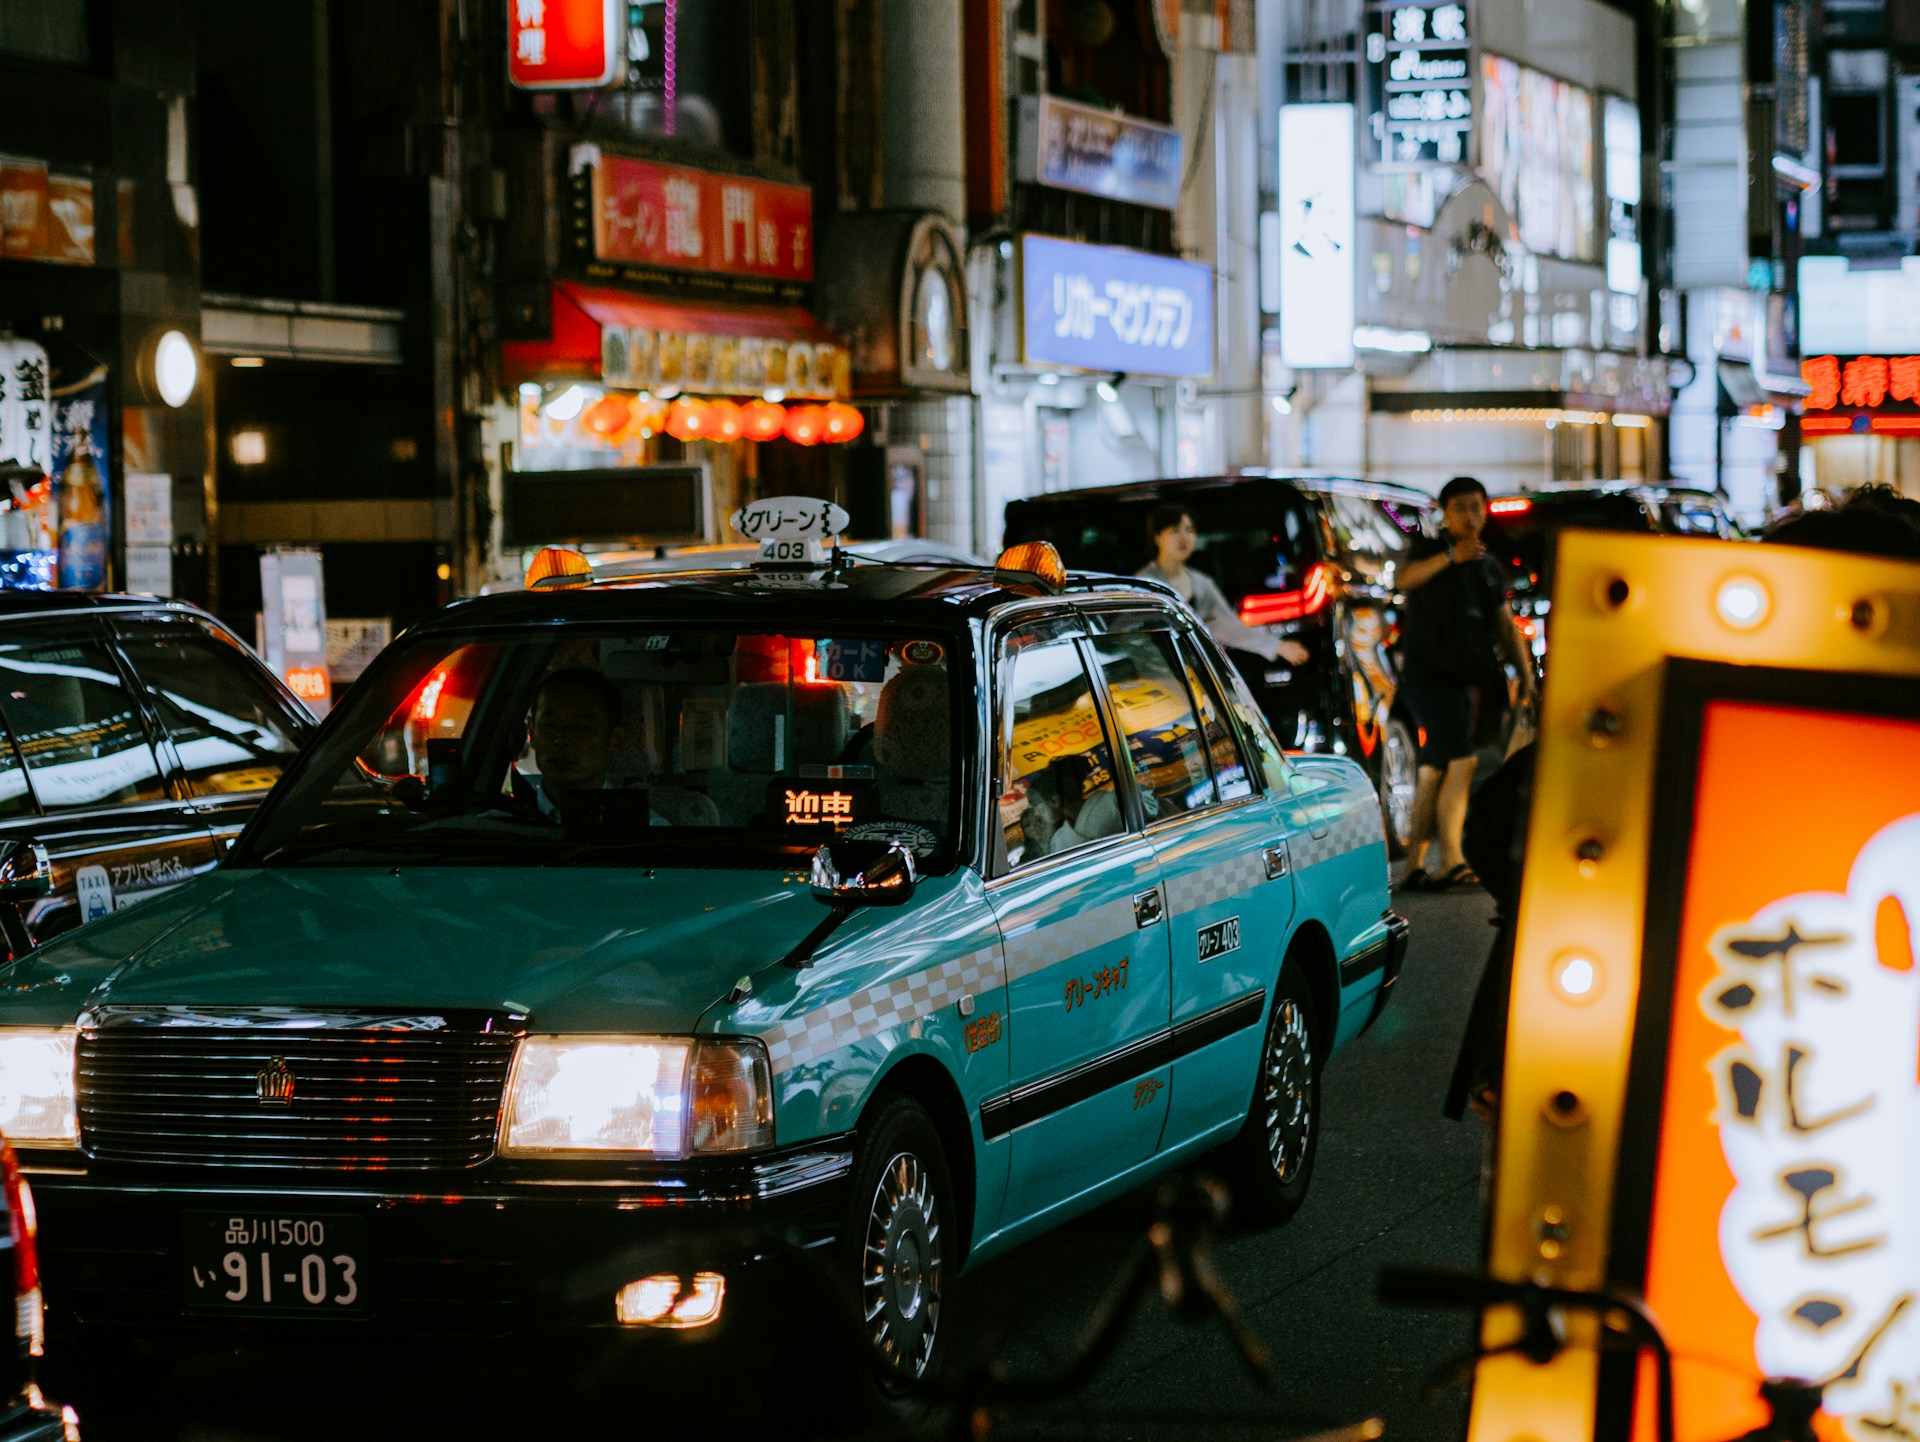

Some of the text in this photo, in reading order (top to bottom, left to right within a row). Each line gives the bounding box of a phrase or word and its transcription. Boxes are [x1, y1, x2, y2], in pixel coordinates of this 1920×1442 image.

[1053, 271, 1193, 349] リカーマウンテン
[747, 509, 817, 534] グリーン
[762, 541, 806, 560] 403
[826, 641, 878, 663] カード
[785, 789, 853, 824] 迎車
[80, 874, 106, 890] TAXI
[1221, 920, 1239, 950] 403
[1065, 956, 1128, 1013] グリーンキャブ
[1133, 1078, 1164, 1111] タクシー
[225, 1218, 324, 1246] 品川500
[193, 1251, 358, 1305] い 91-03
